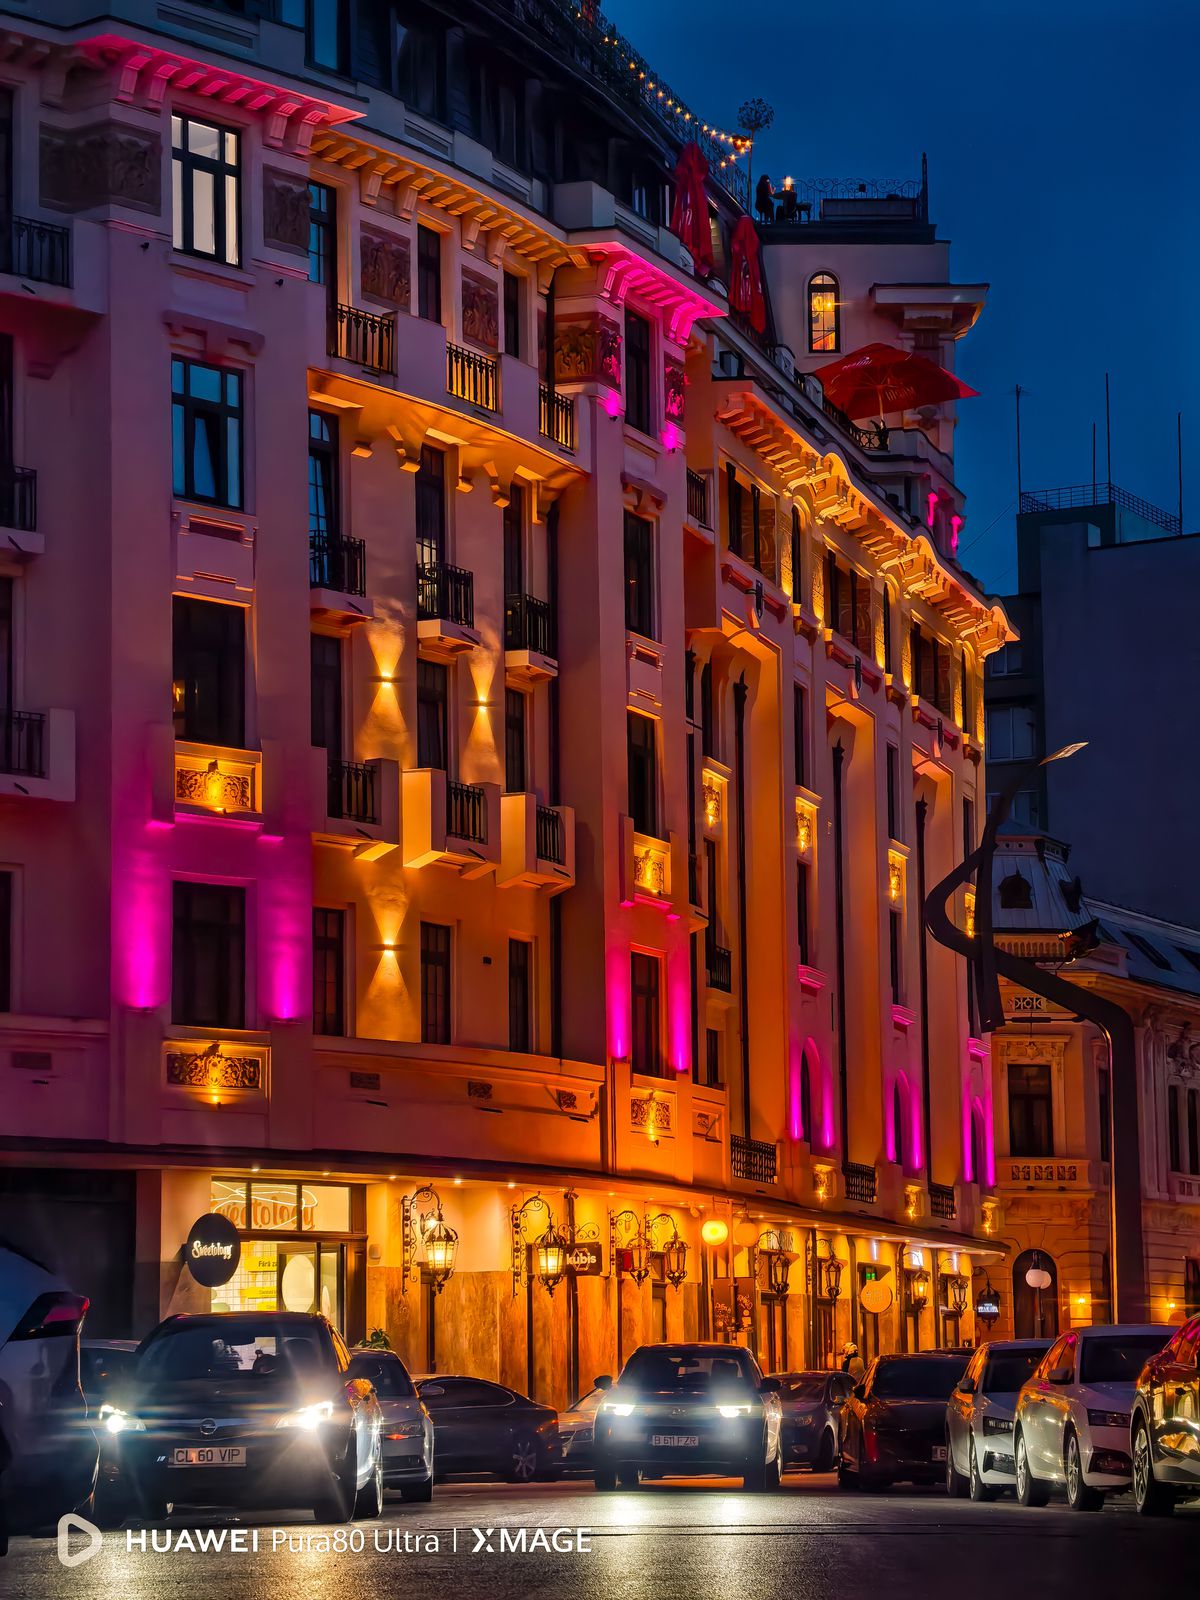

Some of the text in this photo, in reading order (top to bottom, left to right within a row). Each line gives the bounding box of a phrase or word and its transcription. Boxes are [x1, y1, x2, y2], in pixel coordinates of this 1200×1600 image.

[191, 1240, 233, 1260] Sweetology
[566, 1253, 597, 1265] kubis
[176, 1449, 240, 1463] CL 60 VIP
